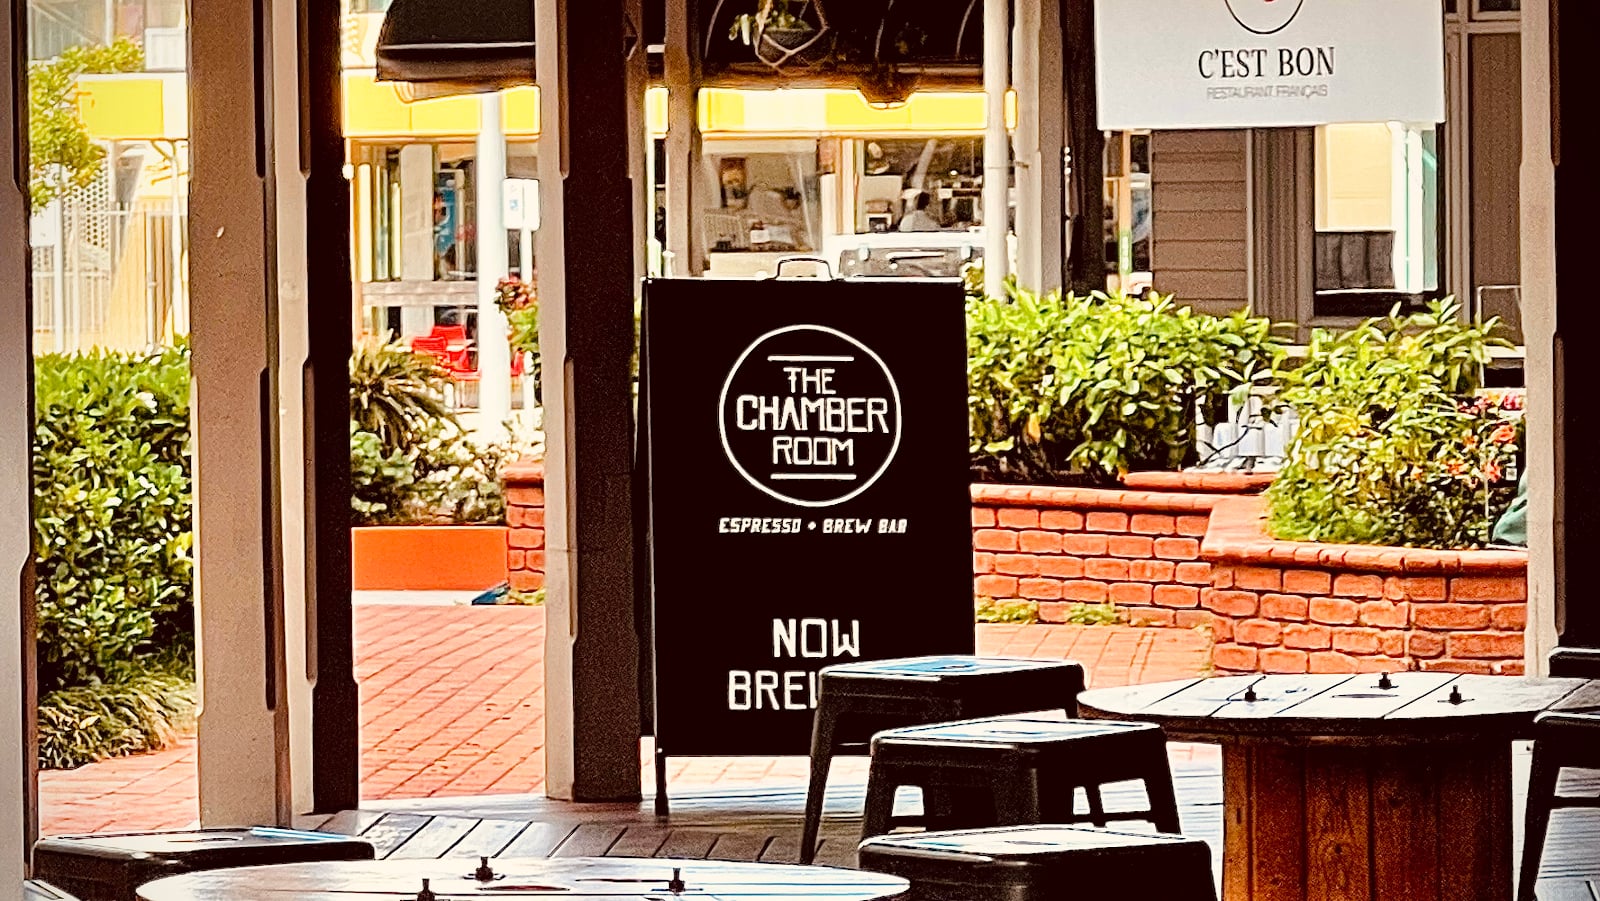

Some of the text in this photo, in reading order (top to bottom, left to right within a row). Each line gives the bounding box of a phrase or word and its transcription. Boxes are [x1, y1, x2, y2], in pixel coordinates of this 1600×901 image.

[1198, 47, 1334, 79] C'EST BON
[1207, 85, 1273, 100] RESTAURANT
[782, 367, 837, 394] THE
[736, 394, 890, 434] CHAMBER
[772, 436, 854, 466] ROOM
[719, 517, 908, 534] ESPRESSO BREW BAR
[772, 618, 861, 658] NOW
